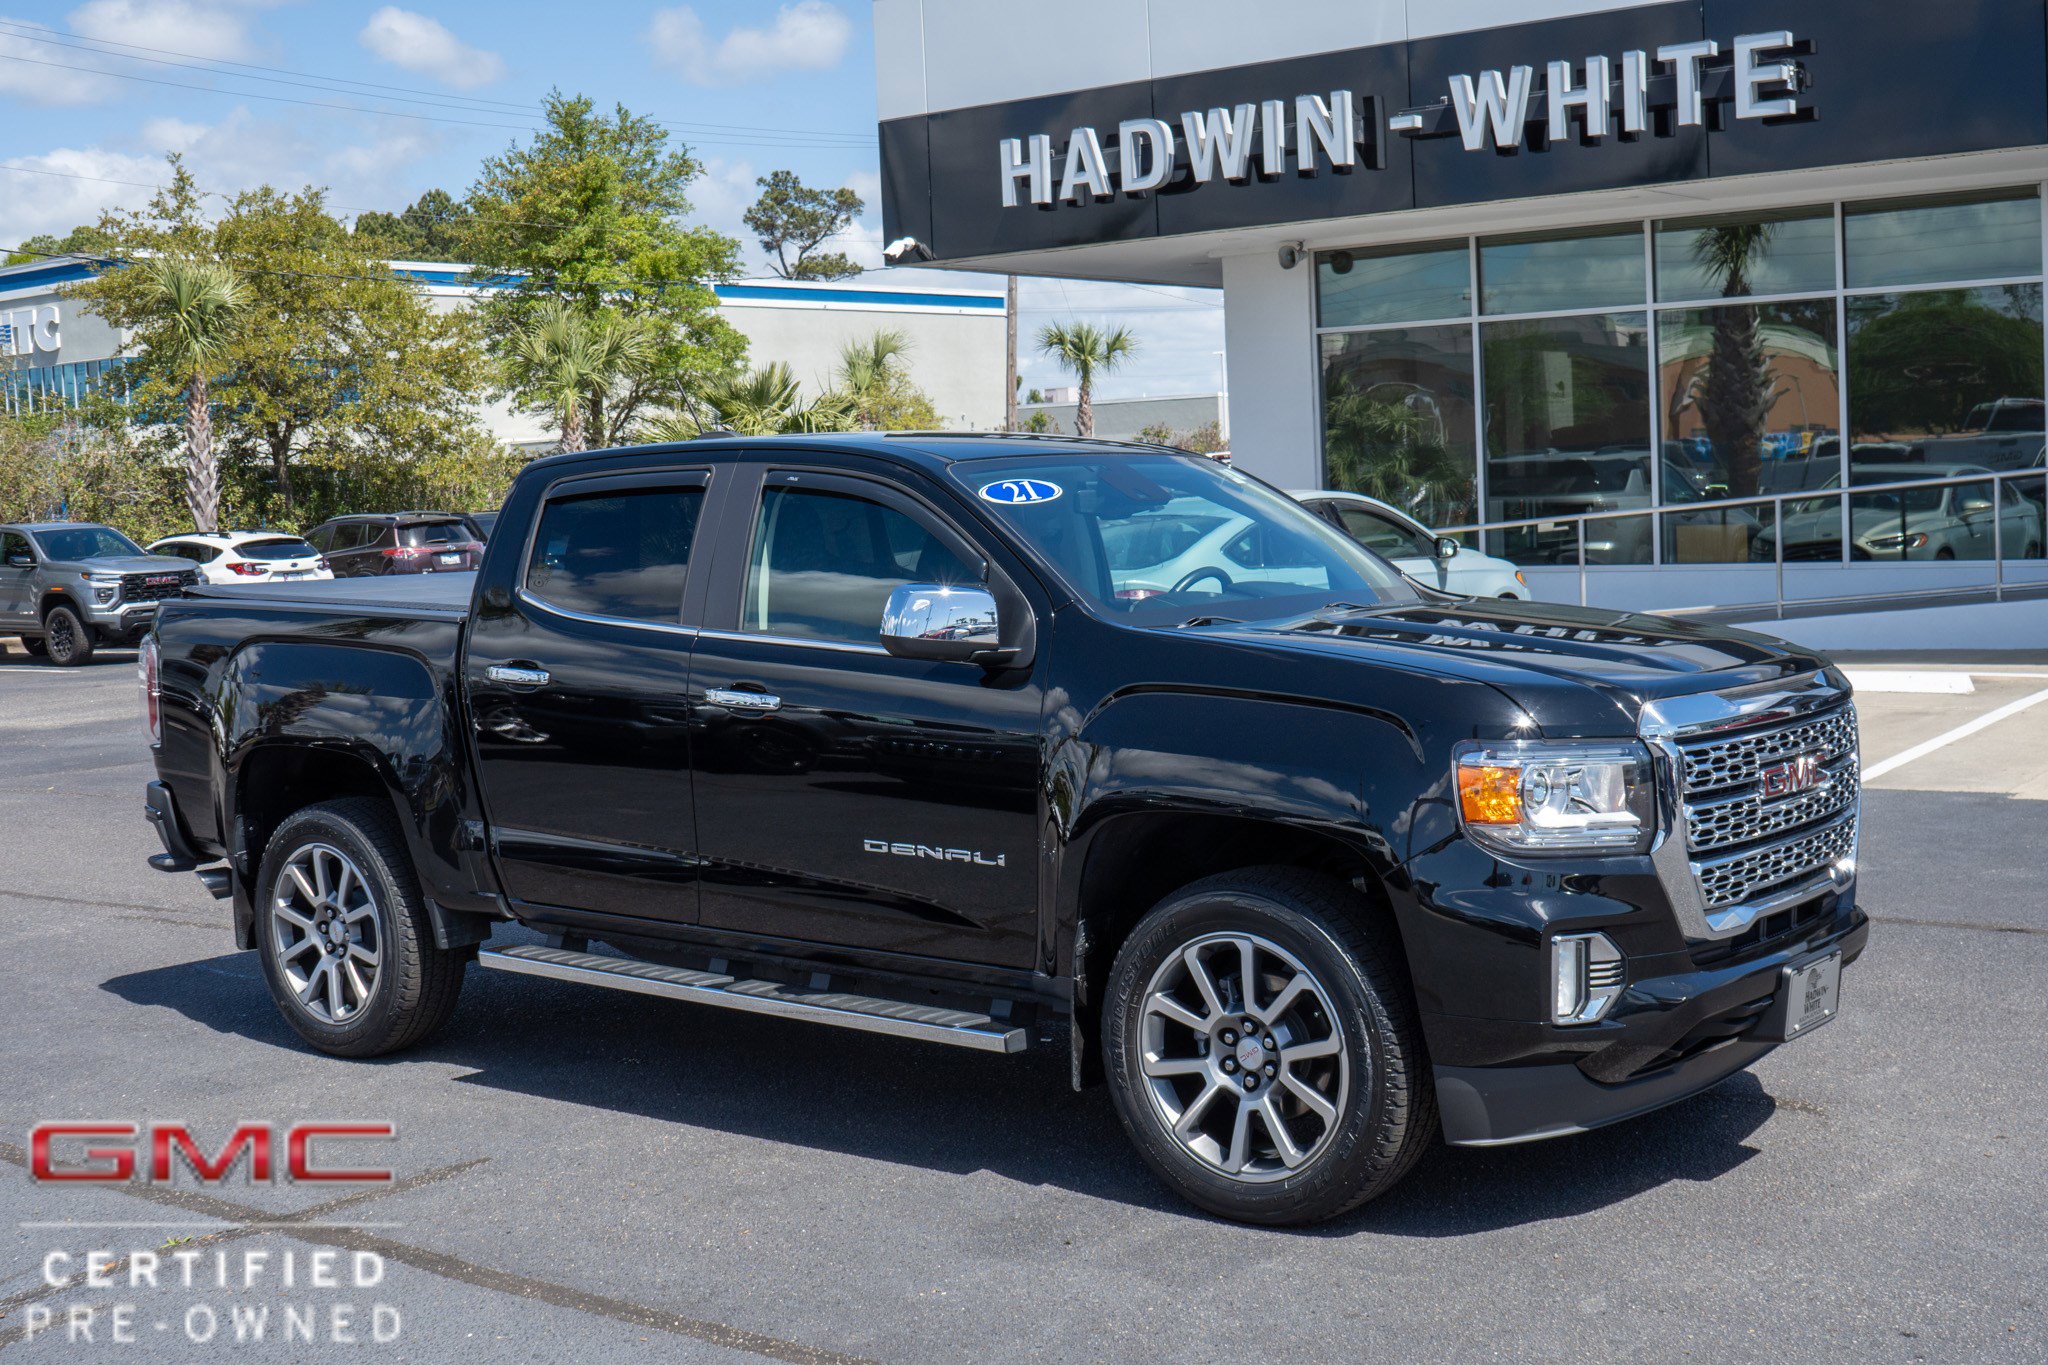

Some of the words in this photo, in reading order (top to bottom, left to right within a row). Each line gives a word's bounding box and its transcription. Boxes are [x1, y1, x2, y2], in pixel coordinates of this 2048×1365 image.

[1000, 90, 1354, 208] HADWIN
[1448, 30, 1797, 152] WHITE
[1002, 481, 1042, 502] 21
[1763, 754, 1829, 798] GMC
[863, 839, 1006, 867] DENALI
[1240, 1046, 1259, 1062] GMC
